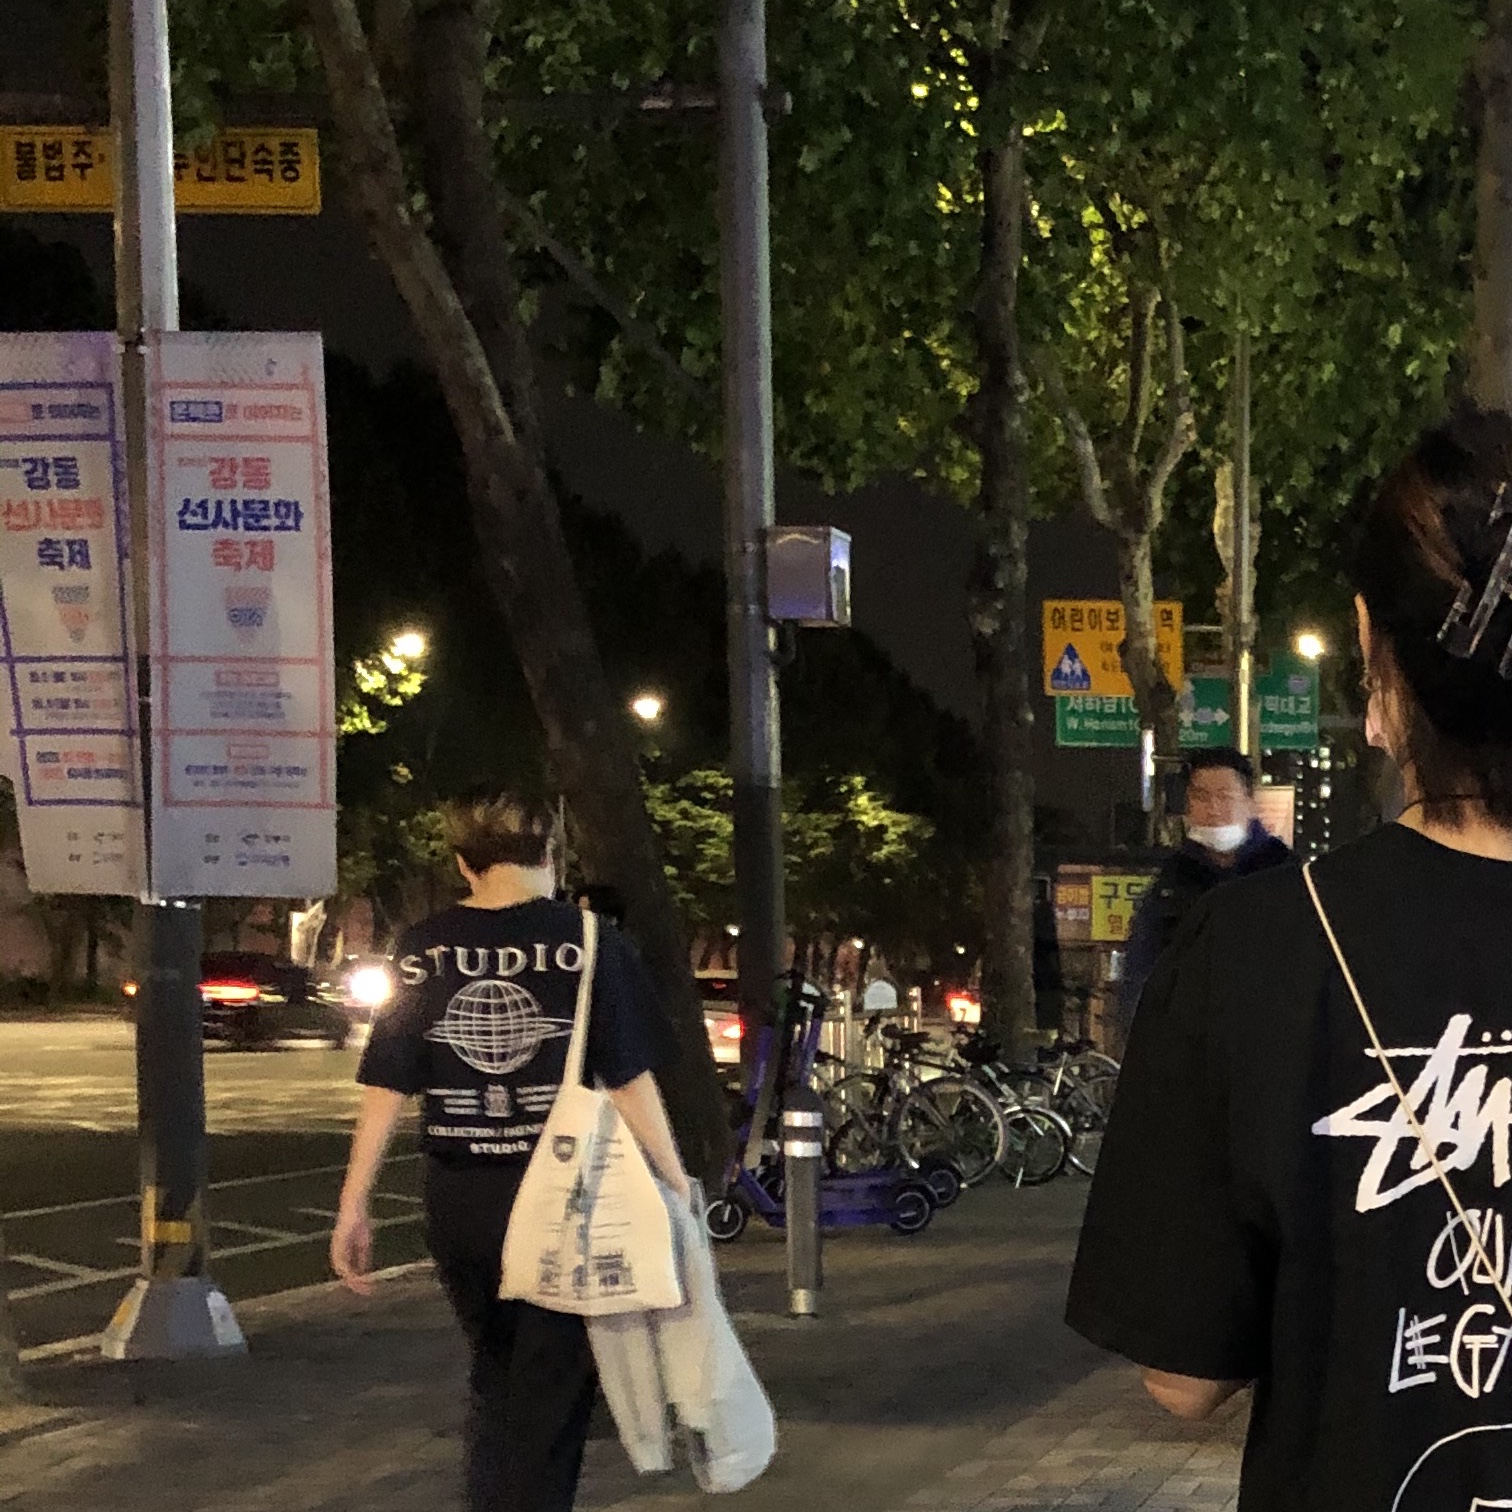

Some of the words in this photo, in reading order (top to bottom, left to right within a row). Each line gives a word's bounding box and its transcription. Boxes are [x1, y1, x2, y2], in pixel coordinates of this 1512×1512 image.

[21, 456, 80, 490] 강동
[208, 456, 272, 490] 강동
[176, 497, 304, 532] 선사문화
[37, 538, 91, 570] 축제
[211, 538, 275, 572] 축제
[401, 942, 583, 985] STUDIO
